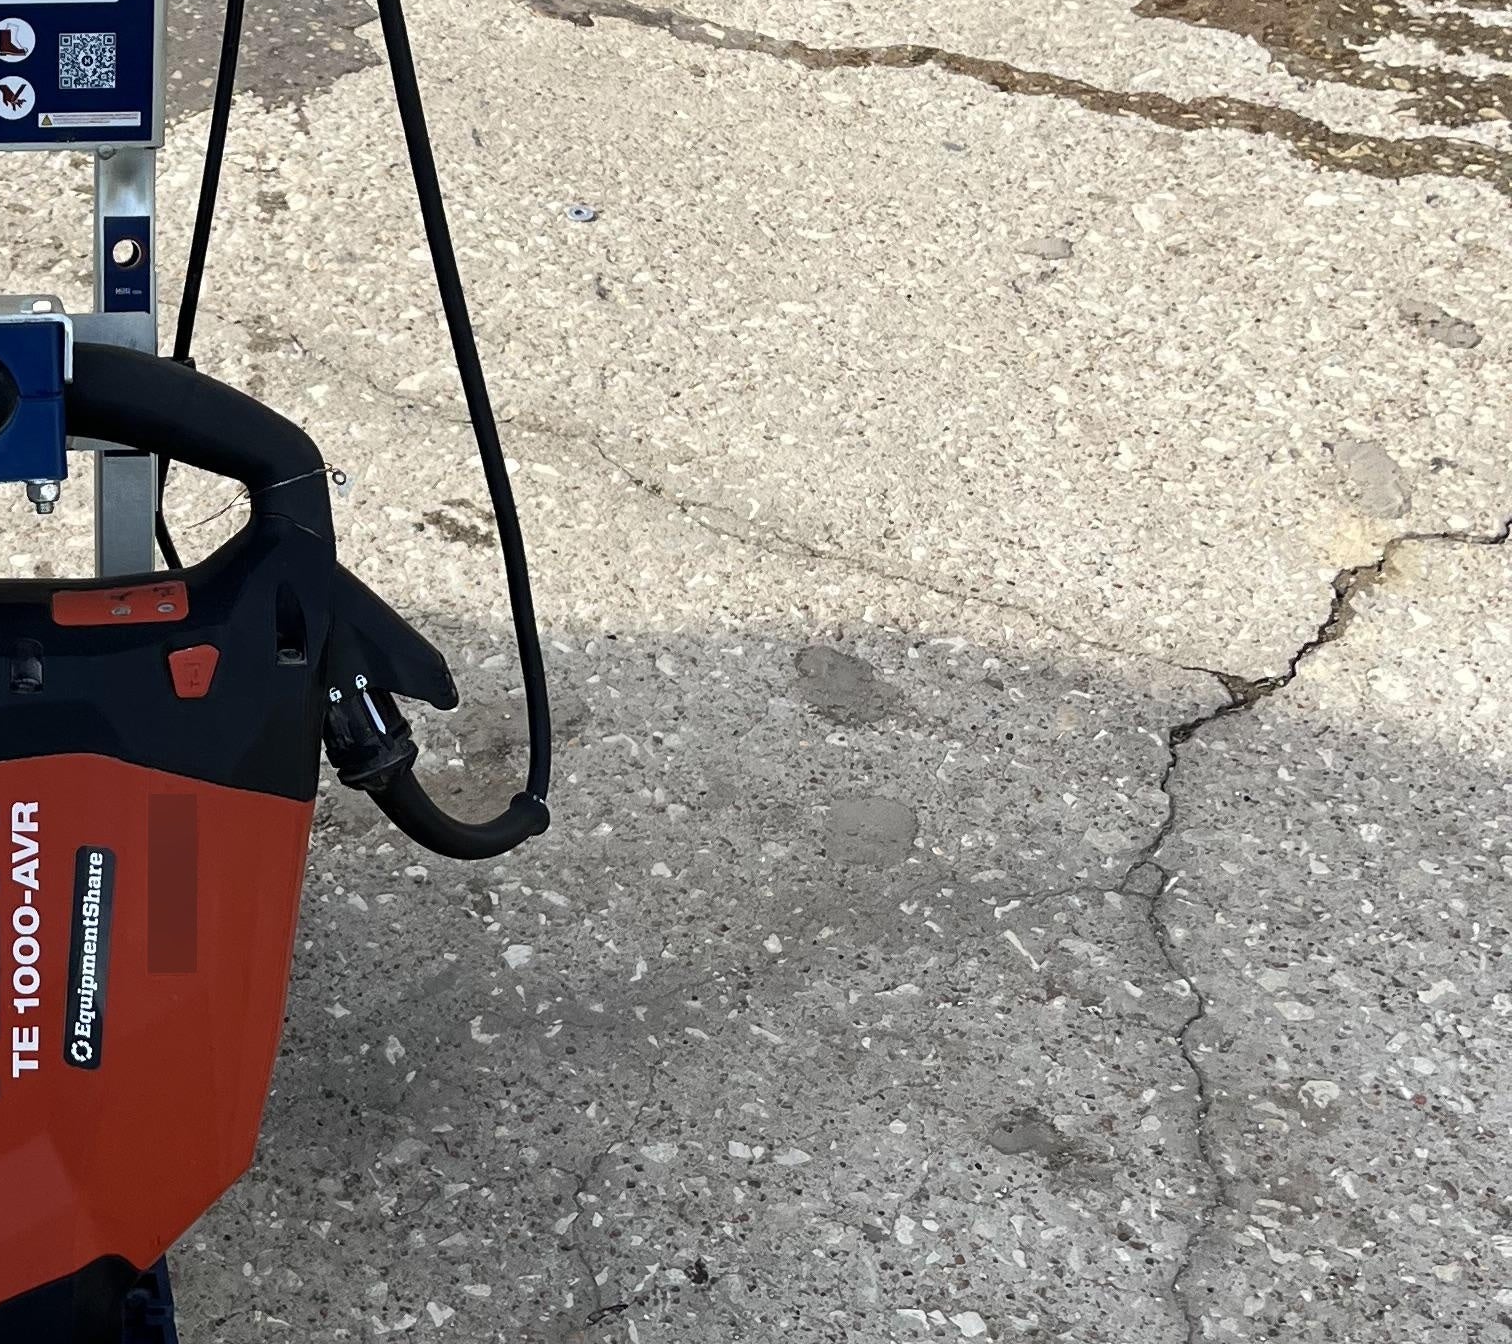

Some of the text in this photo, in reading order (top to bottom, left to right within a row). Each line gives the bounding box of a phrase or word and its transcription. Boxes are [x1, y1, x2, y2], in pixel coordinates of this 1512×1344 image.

[11, 801, 41, 1078] TE 1000-AVR
[74, 851, 103, 1038] EquipmentShare
